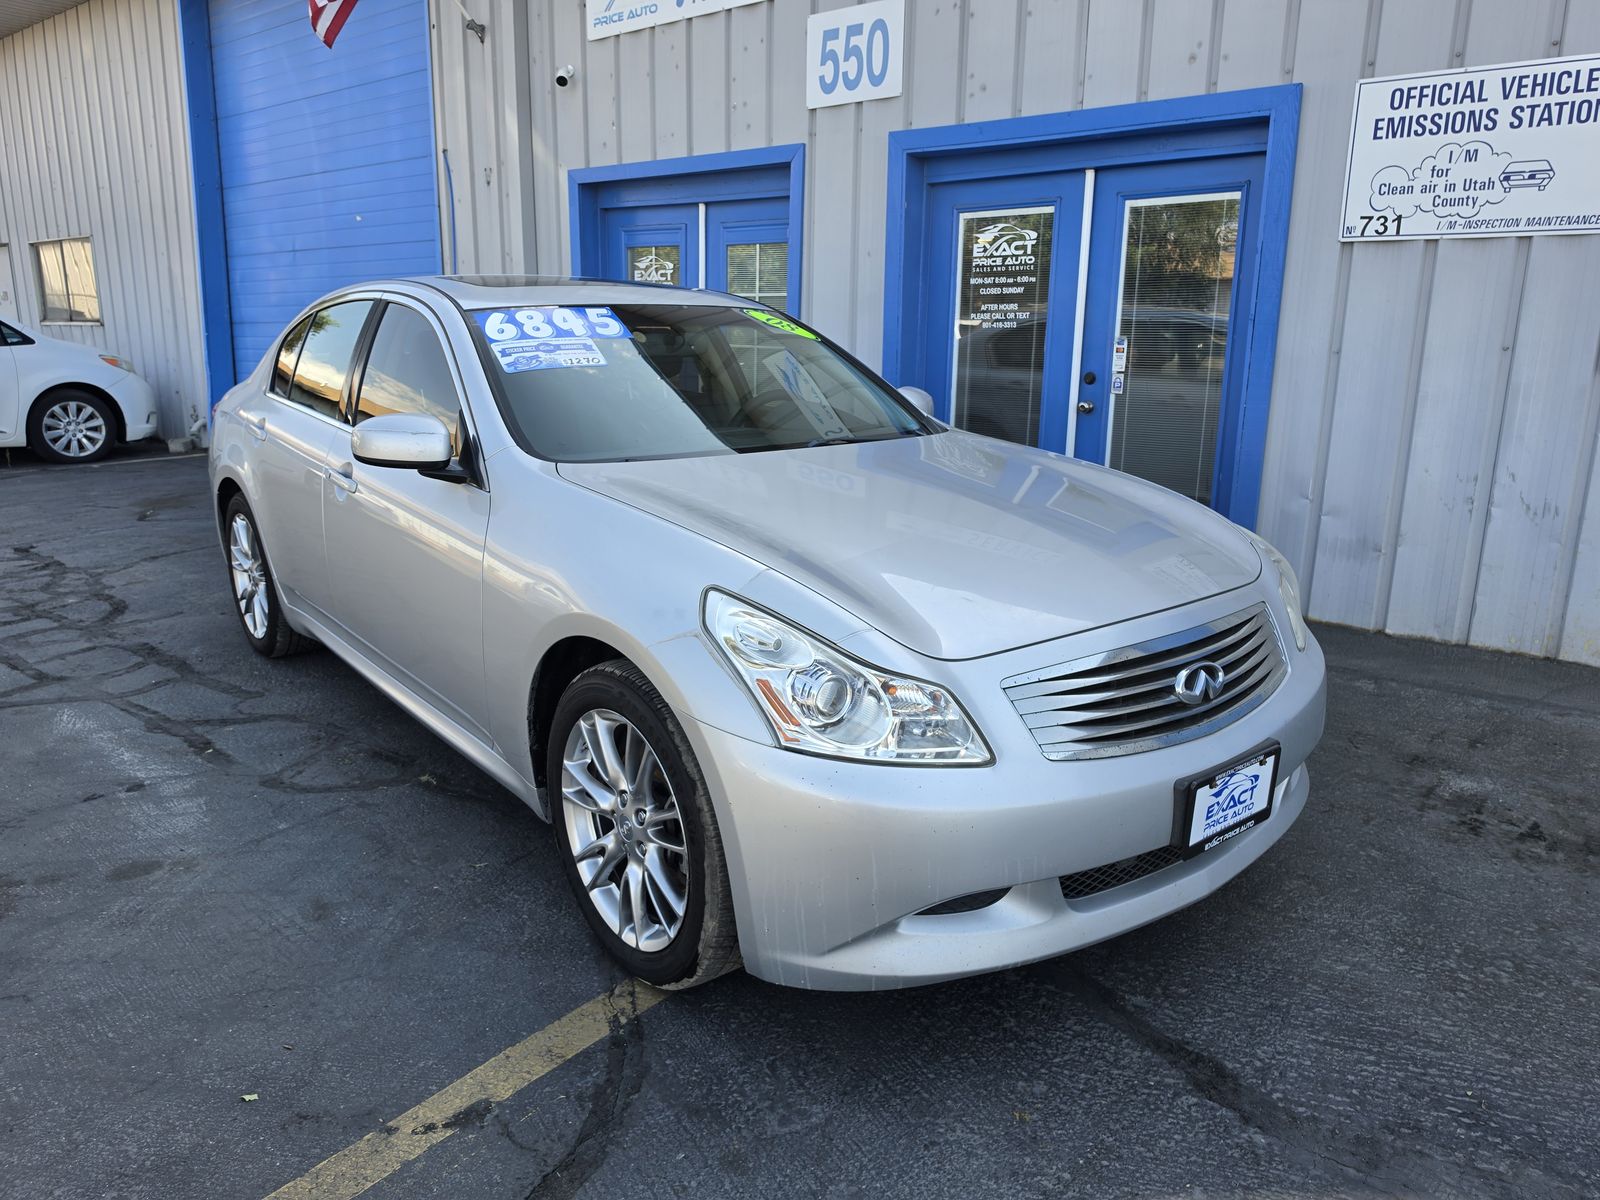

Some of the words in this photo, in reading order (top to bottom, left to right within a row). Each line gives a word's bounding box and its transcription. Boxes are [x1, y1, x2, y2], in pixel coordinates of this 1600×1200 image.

[593, 11, 624, 28] PRICE
[627, 4, 658, 21] AUTO
[818, 18, 890, 95] 550
[1389, 79, 1488, 111] OFFICIAL
[1501, 68, 1600, 100] VEHICLE
[1372, 107, 1499, 141] EMISSIONS
[1448, 148, 1479, 164] I/M
[1430, 165, 1452, 178] for
[1378, 182, 1414, 196] Clean
[1420, 180, 1439, 194] air
[1444, 179, 1456, 193] in
[1463, 177, 1495, 192] Utah
[1432, 194, 1479, 209] County
[1360, 214, 1402, 237] 731
[1524, 214, 1600, 226] MAINTENANCE
[973, 239, 1037, 257] EXACT
[973, 257, 1003, 267] PRICE
[1004, 255, 1035, 265] AUTO
[634, 269, 674, 281] EXACT
[970, 276, 995, 285] MON-SAT
[979, 287, 1002, 295] CLOSED
[1002, 286, 1025, 294] SUNDAY
[485, 308, 623, 341] 6845
[970, 312, 992, 320] PLEASE
[991, 312, 1006, 320] CALL
[1015, 311, 1031, 319] TEXT
[1205, 784, 1258, 821] EXACT
[1203, 814, 1229, 832] PRICE
[1230, 802, 1254, 819] AUTO
